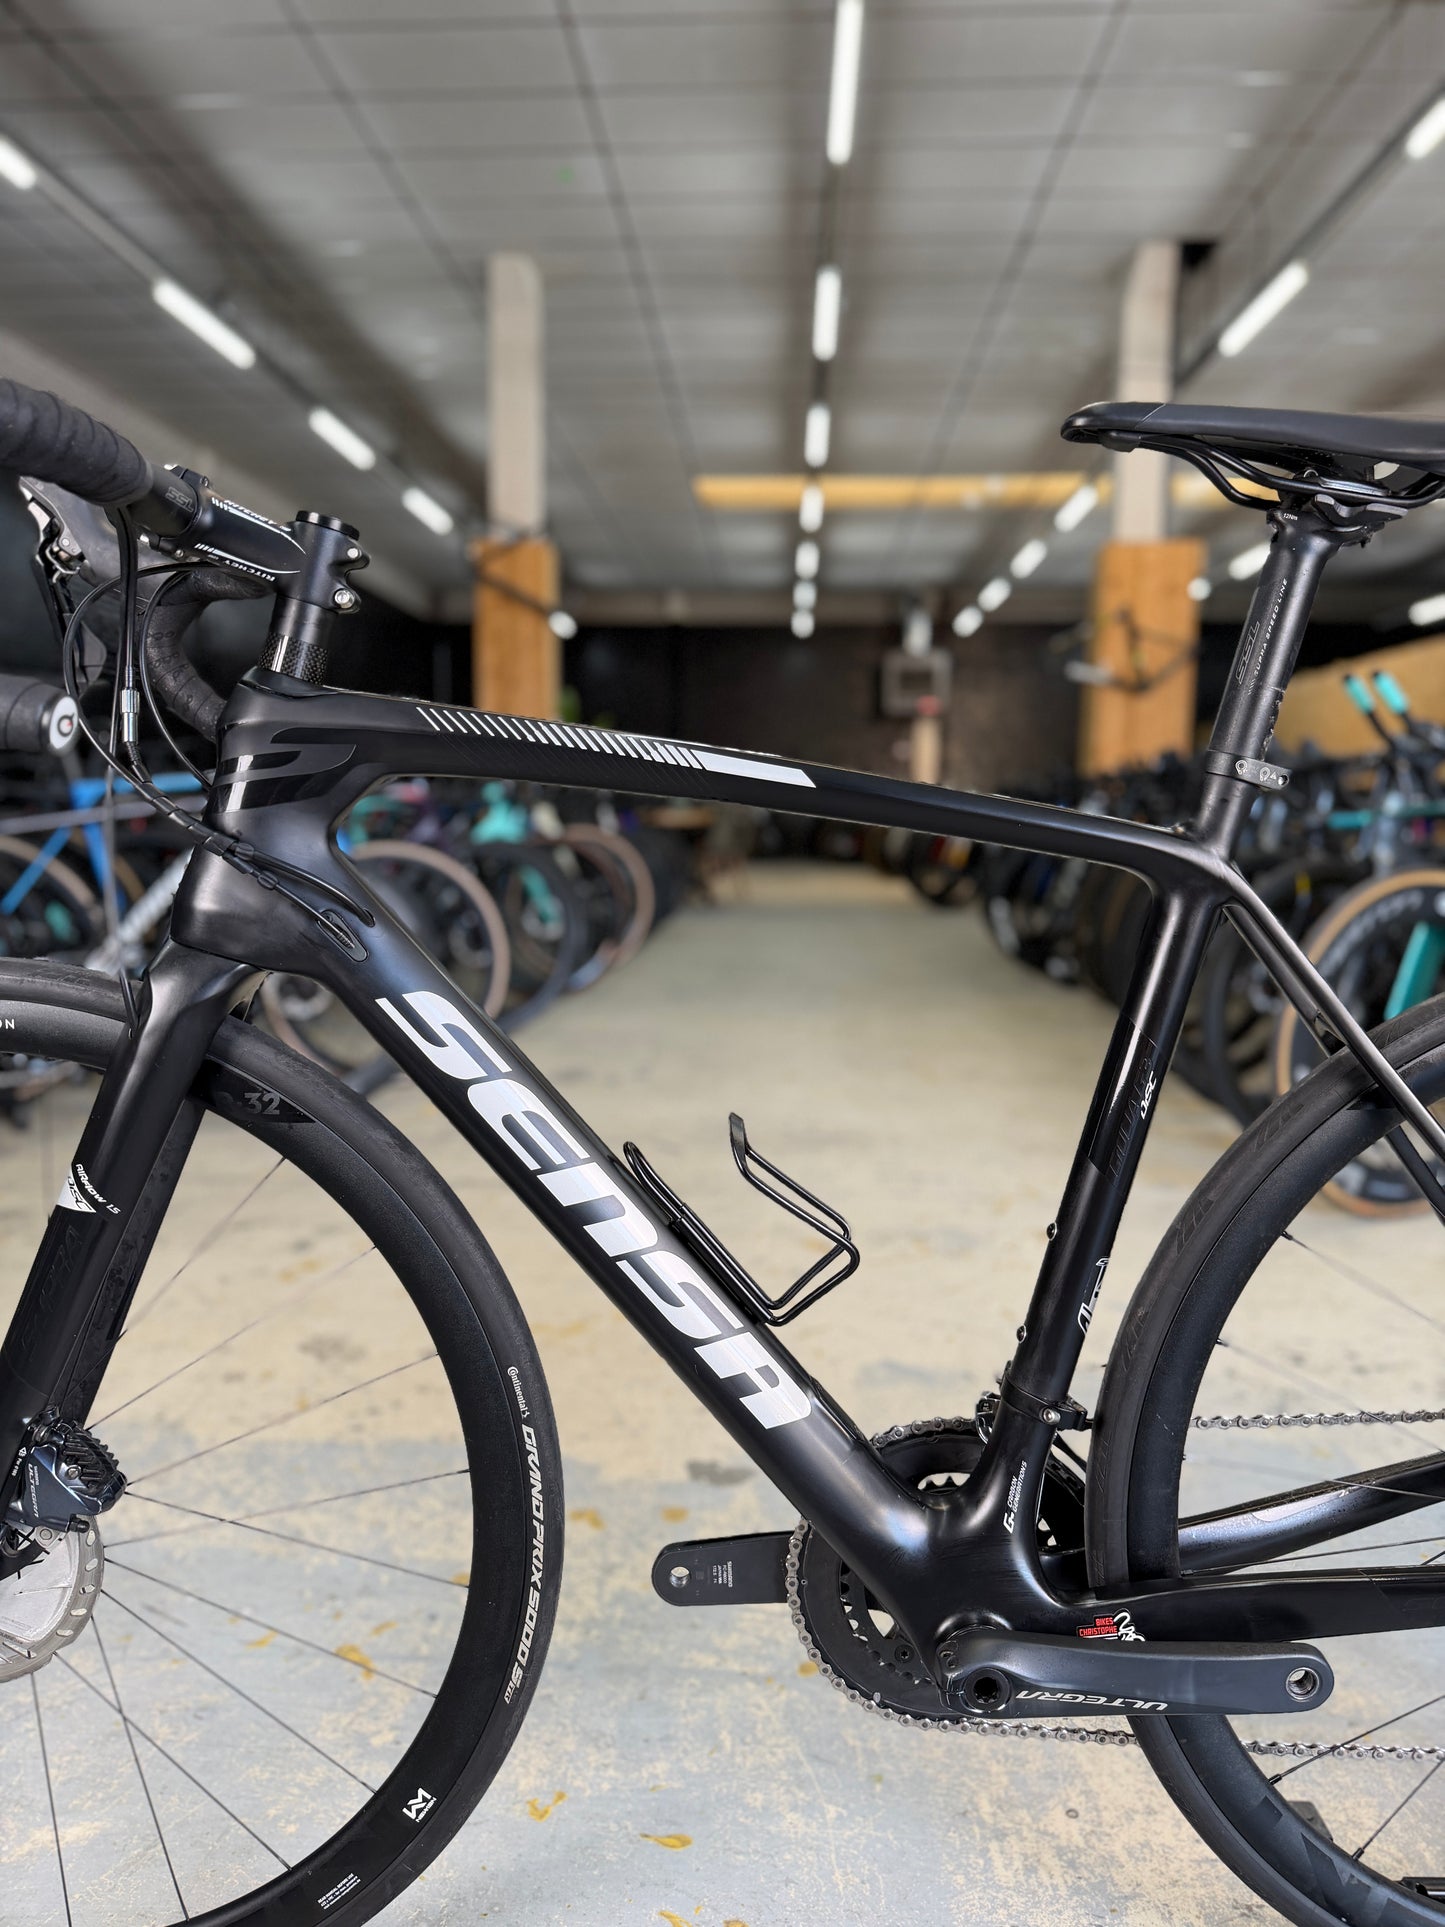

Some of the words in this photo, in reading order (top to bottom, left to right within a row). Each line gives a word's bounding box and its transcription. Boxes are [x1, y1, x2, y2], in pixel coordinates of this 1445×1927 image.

[165, 486, 194, 513] SSL
[223, 560, 276, 582] RITCHEY
[1265, 604, 1280, 641] SPEED
[1277, 578, 1288, 603] LINE
[1235, 621, 1260, 685] SSL
[0, 1018, 15, 1030] N
[1140, 1070, 1157, 1120] DISC
[507, 1366, 528, 1413] Continental
[27, 1463, 39, 1518] ULTEGRA
[522, 1423, 545, 1521] GRAND
[1007, 1475, 1019, 1508] CARBON
[1012, 1460, 1027, 1513] GENERATIONS
[530, 1518, 545, 1590] PRIX
[516, 1586, 541, 1667] 5000
[1078, 1625, 1118, 1637] CHRISTOPHE
[1094, 1616, 1114, 1626] BIKES
[1015, 1690, 1169, 1711] ULTEGRA
